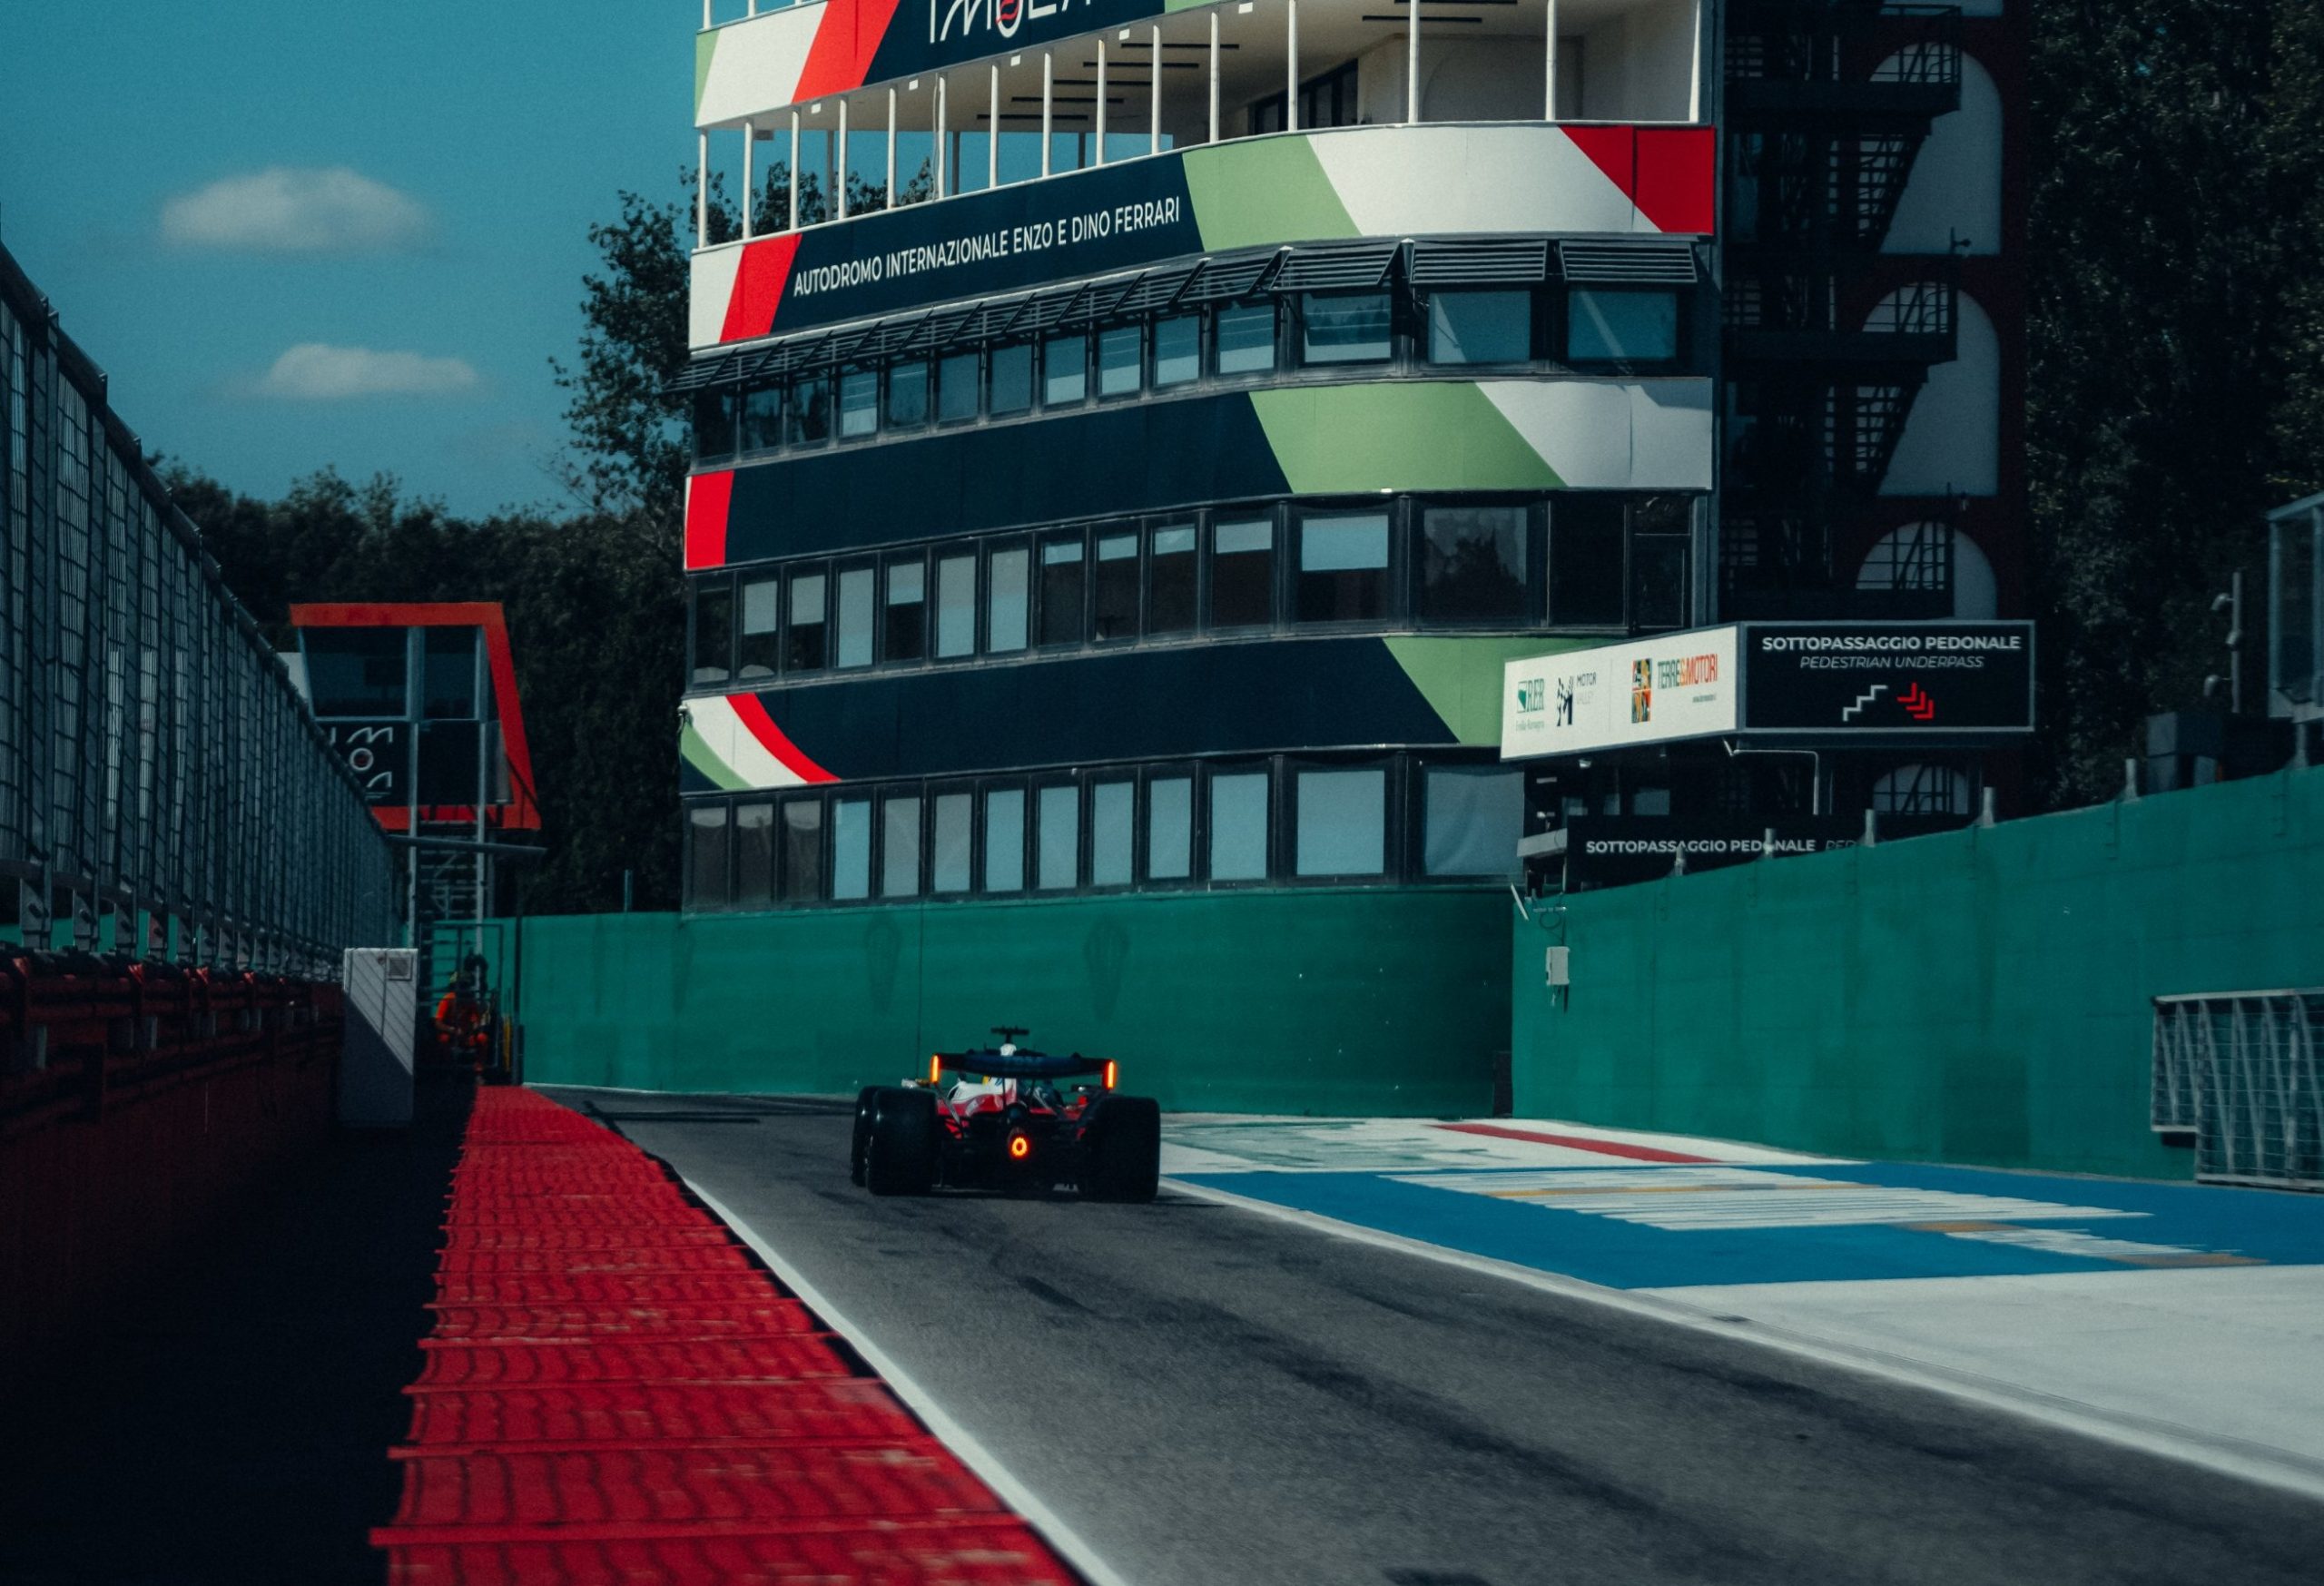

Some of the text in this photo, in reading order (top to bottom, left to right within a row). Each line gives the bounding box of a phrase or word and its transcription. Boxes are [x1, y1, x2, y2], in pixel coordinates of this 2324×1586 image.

[793, 196, 1179, 297] AUTODROMO INTERNAZIONALE ENZO E DINO FERRARI
[1762, 636, 2021, 650] SOTTOPASSAGGIO PEDONALE
[1800, 655, 1984, 669] PEDESTRIAN UNDERPASS
[1577, 672, 1597, 686] MOTOR
[1586, 840, 1726, 853] SOTTOPASSAGGIO
